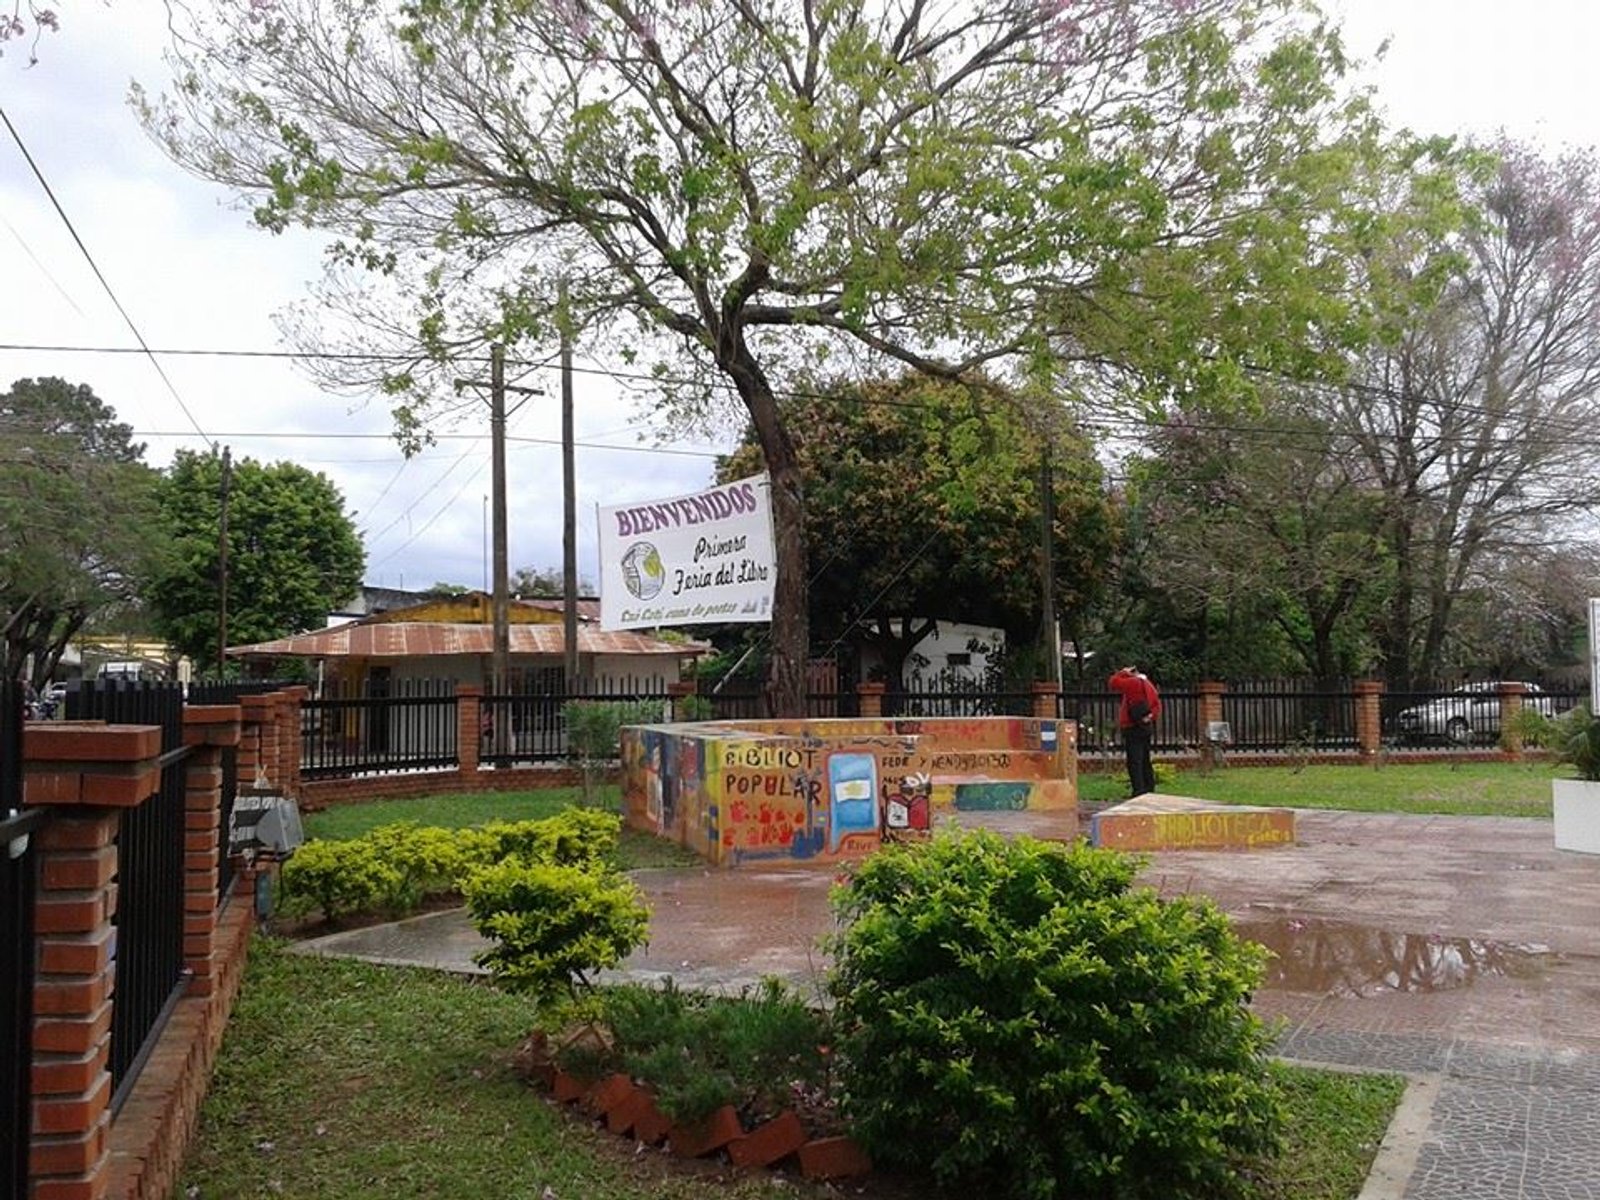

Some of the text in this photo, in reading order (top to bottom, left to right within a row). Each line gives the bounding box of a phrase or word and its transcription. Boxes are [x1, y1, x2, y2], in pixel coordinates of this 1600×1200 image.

[615, 483, 757, 537] BIENVENIDOS
[693, 534, 747, 563] Primera
[672, 559, 768, 596] Feria del Libro
[726, 774, 822, 807] POPULAR
